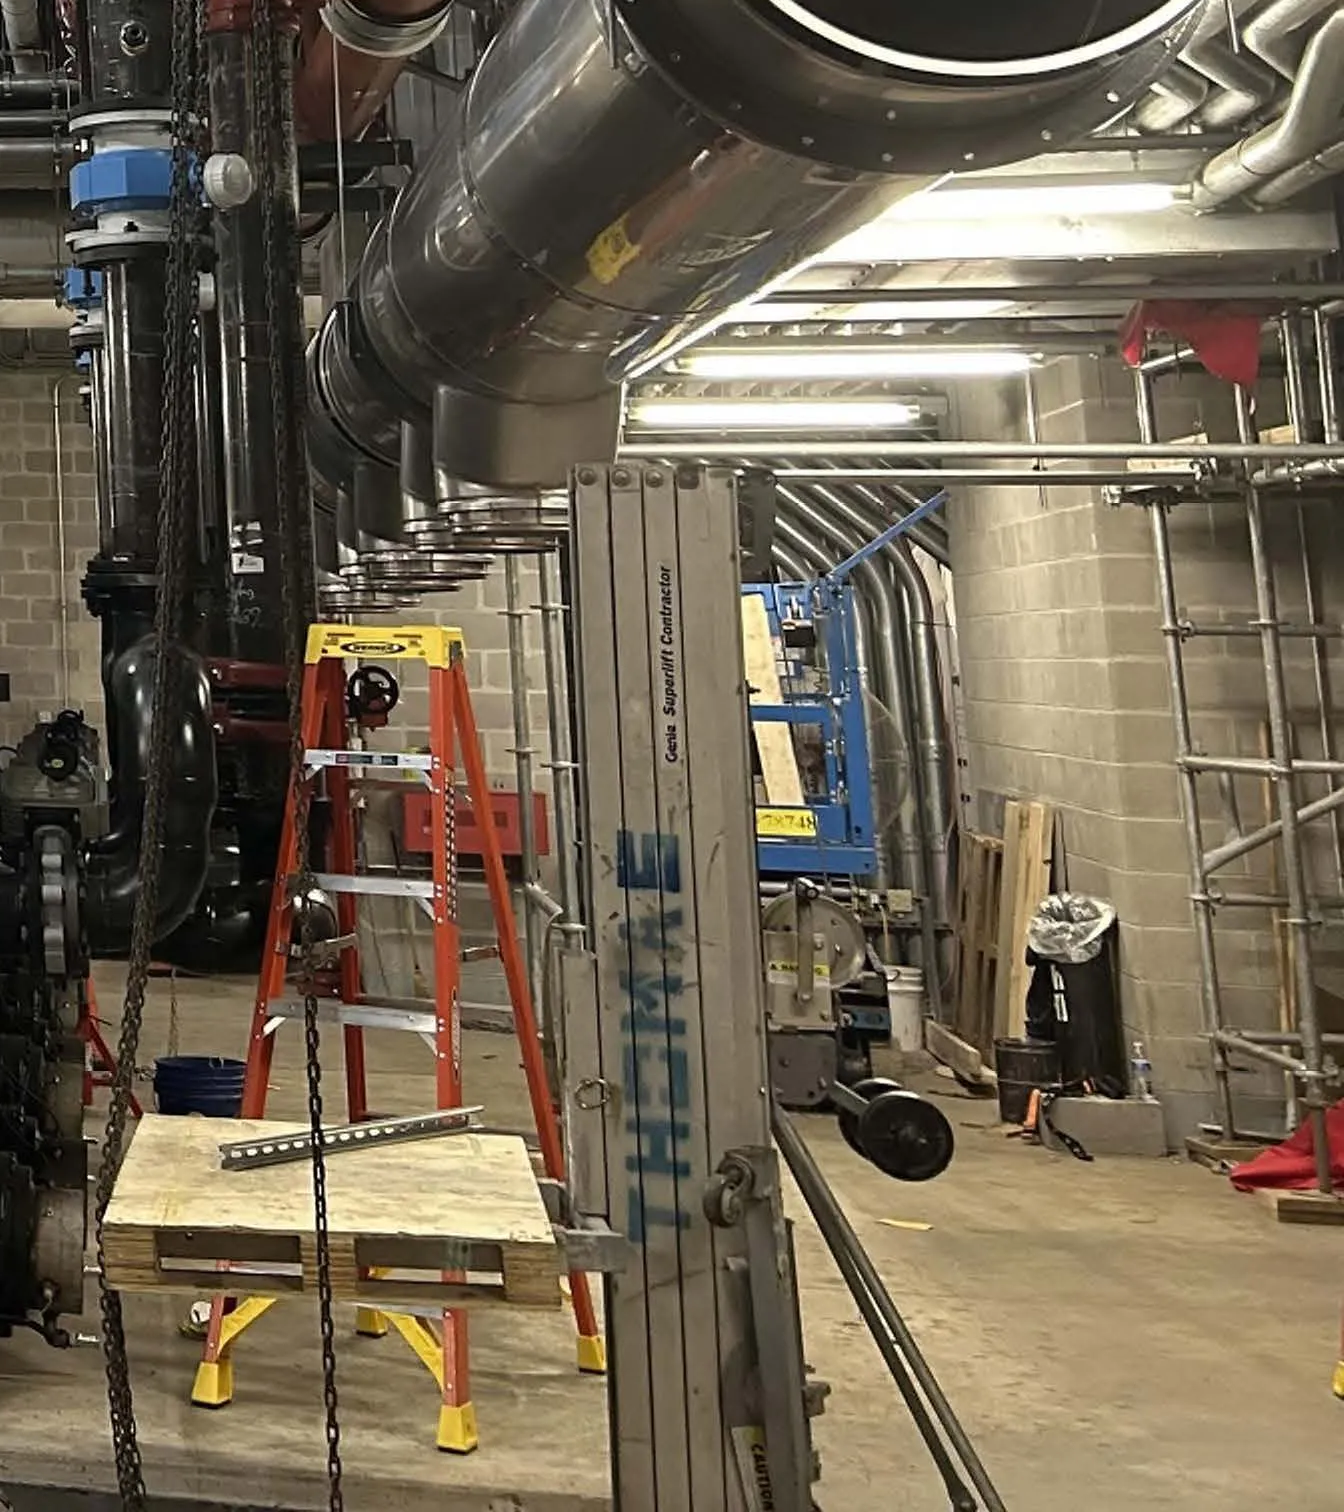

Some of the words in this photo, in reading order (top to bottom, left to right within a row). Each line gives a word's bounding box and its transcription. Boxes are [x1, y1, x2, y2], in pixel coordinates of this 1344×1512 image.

[659, 566, 673, 645] Contractor
[660, 650, 677, 717] Superlift
[665, 724, 678, 763] Genie
